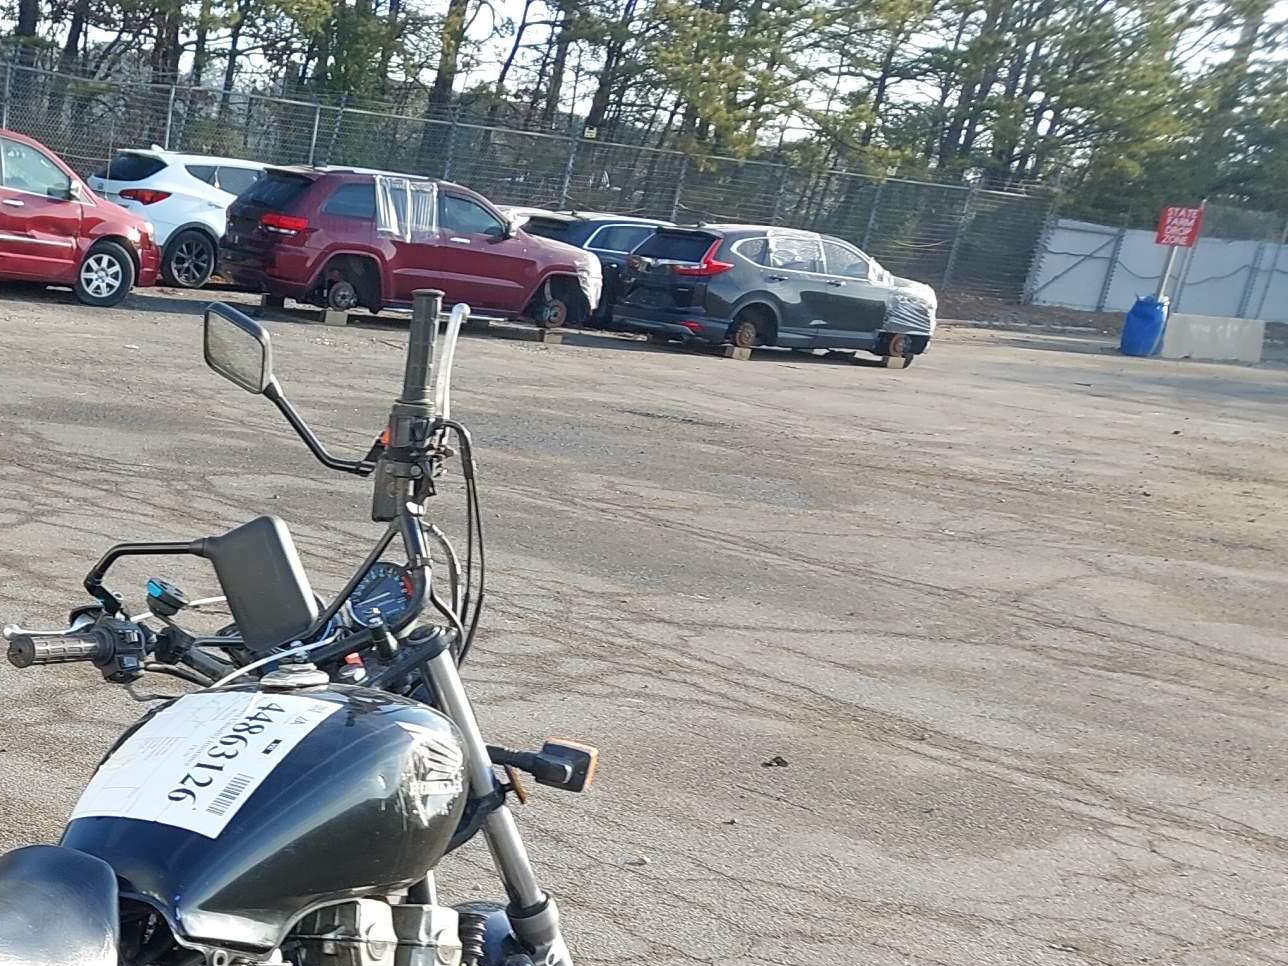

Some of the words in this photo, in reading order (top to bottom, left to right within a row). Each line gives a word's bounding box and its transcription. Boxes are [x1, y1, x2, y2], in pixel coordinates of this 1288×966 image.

[1167, 207, 1199, 218] STATE
[1166, 216, 1196, 227] FARM
[1164, 225, 1192, 236] DROP
[1161, 235, 1189, 245] ZONE
[167, 702, 286, 806] 44863126
